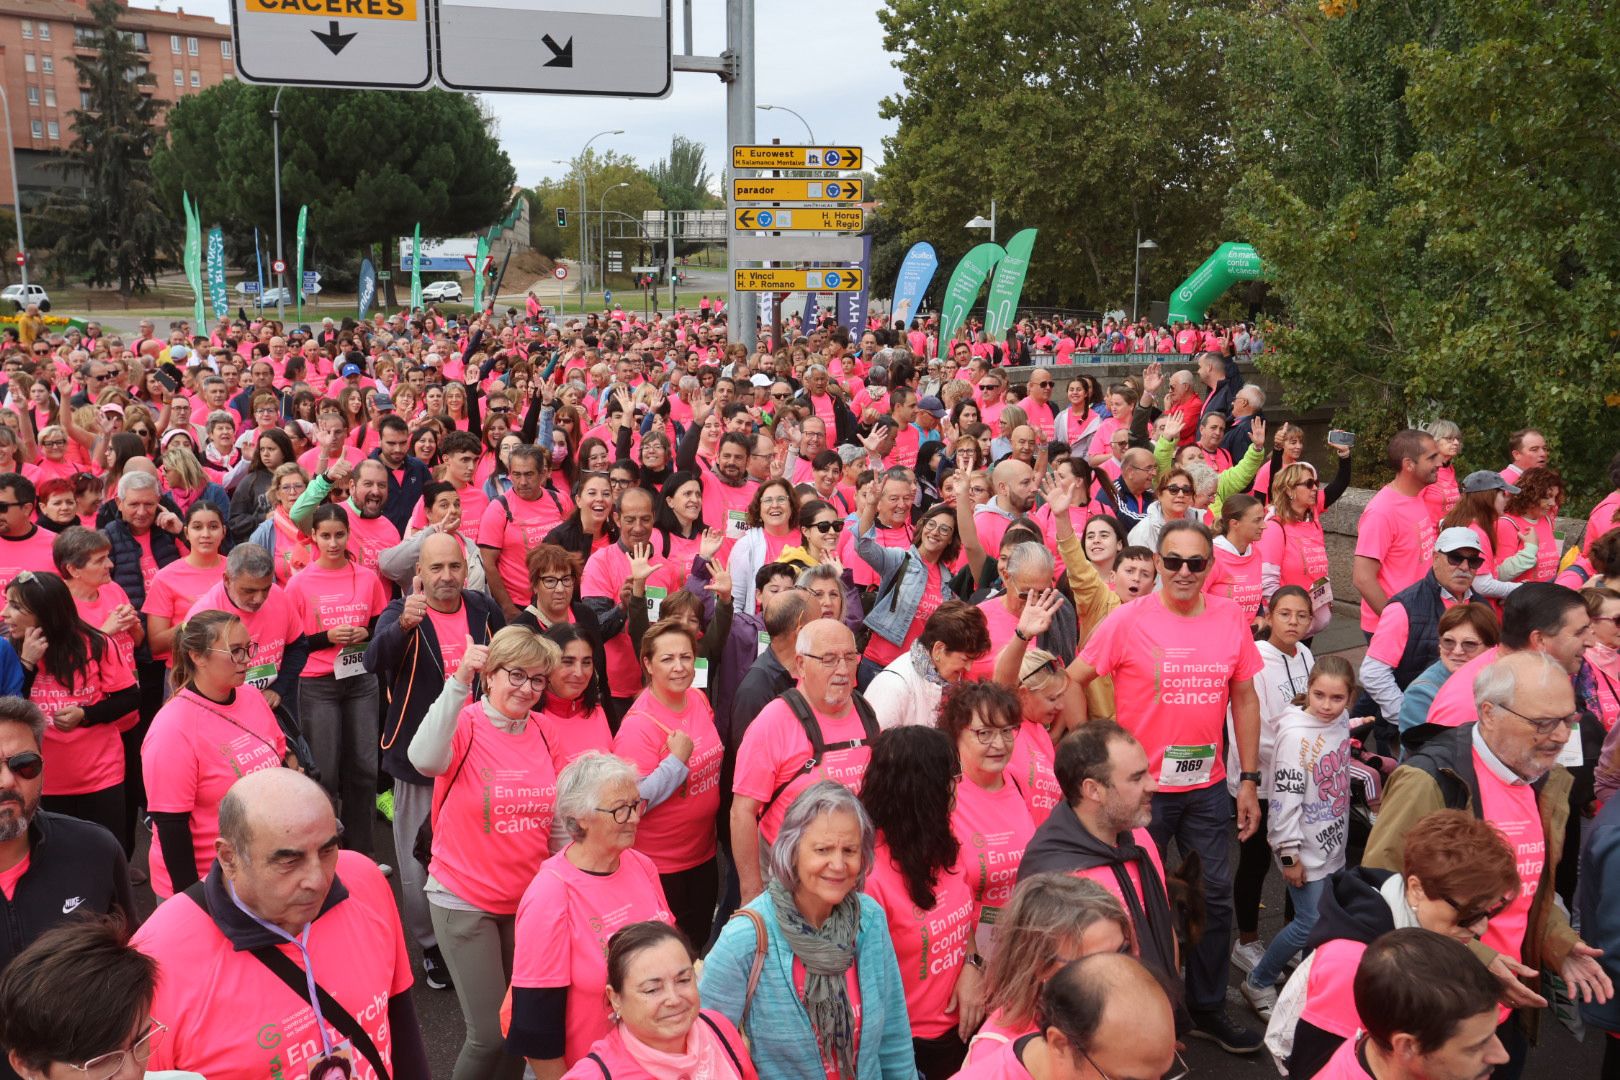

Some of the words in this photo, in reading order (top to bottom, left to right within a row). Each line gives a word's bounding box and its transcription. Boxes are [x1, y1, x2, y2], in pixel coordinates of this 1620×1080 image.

[750, 149, 794, 158] Eurowest
[737, 186, 775, 195] parador
[834, 211, 860, 220] Horus
[836, 220, 860, 229] Regio
[749, 272, 775, 280] Vincci
[760, 280, 795, 288] Romano
[320, 604, 336, 616] En
[322, 613, 360, 627] contra
[342, 652, 364, 666] 5758
[1162, 661, 1180, 673] En
[1183, 660, 1229, 673] marcha
[1162, 674, 1212, 689] contra
[1214, 673, 1226, 688] el
[30, 687, 50, 699] En
[1162, 687, 1224, 705] cáncer
[236, 752, 250, 766] En
[1175, 759, 1203, 773] 7869
[494, 785, 514, 799] En
[517, 784, 557, 799] march
[493, 801, 550, 816] contra
[1315, 815, 1346, 844] URBAN
[1319, 830, 1345, 856] TRIP
[987, 850, 1005, 865] En
[65, 896, 80, 908] NIKE
[930, 918, 947, 936] En
[286, 1039, 319, 1067] En
